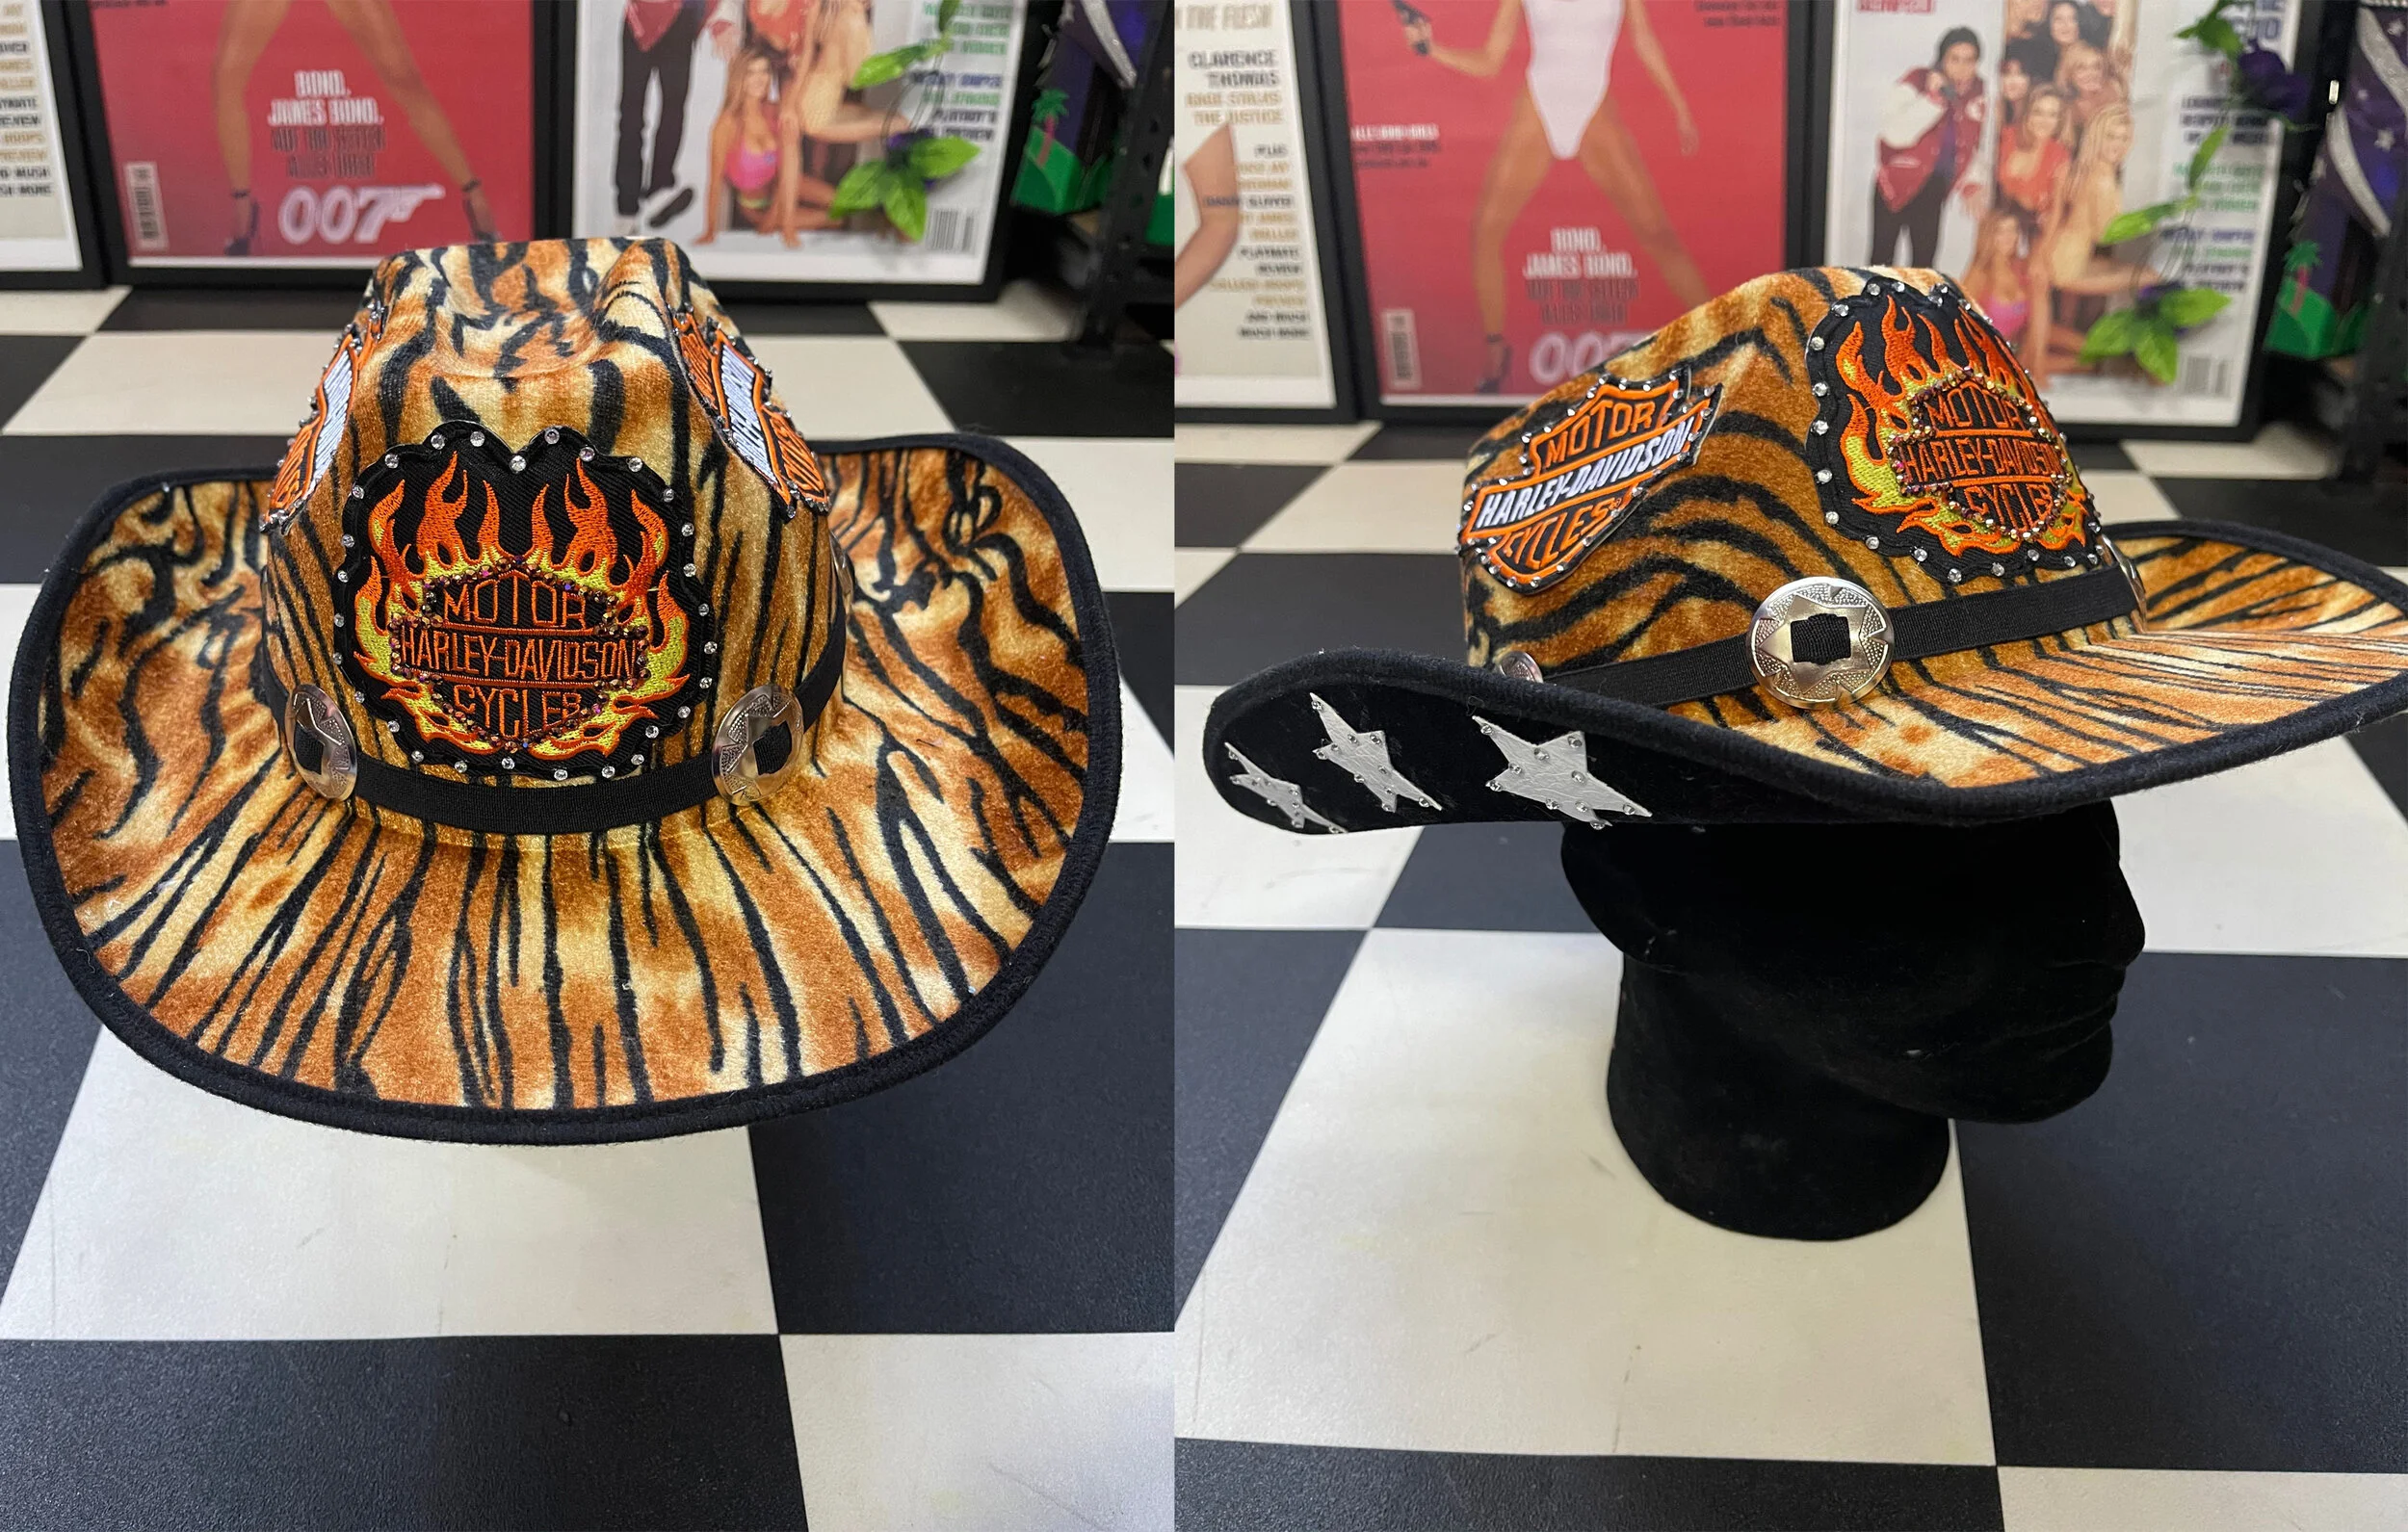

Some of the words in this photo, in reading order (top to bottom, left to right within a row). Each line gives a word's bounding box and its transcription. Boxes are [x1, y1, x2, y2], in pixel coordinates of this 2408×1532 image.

[1188, 50, 1276, 68] CLARENCE
[1207, 71, 1279, 88] THOMAS
[268, 98, 327, 126] JAMES
[277, 184, 416, 244] 007
[1523, 252, 1582, 279] JAMES
[1924, 382, 2023, 433] MOTOR
[1545, 400, 1655, 469] MOTOR
[1476, 416, 1695, 529] HARLEY-DAVIDSON
[443, 572, 587, 630] MOTOR
[400, 626, 639, 682] HARLEY-DAVIDSON
